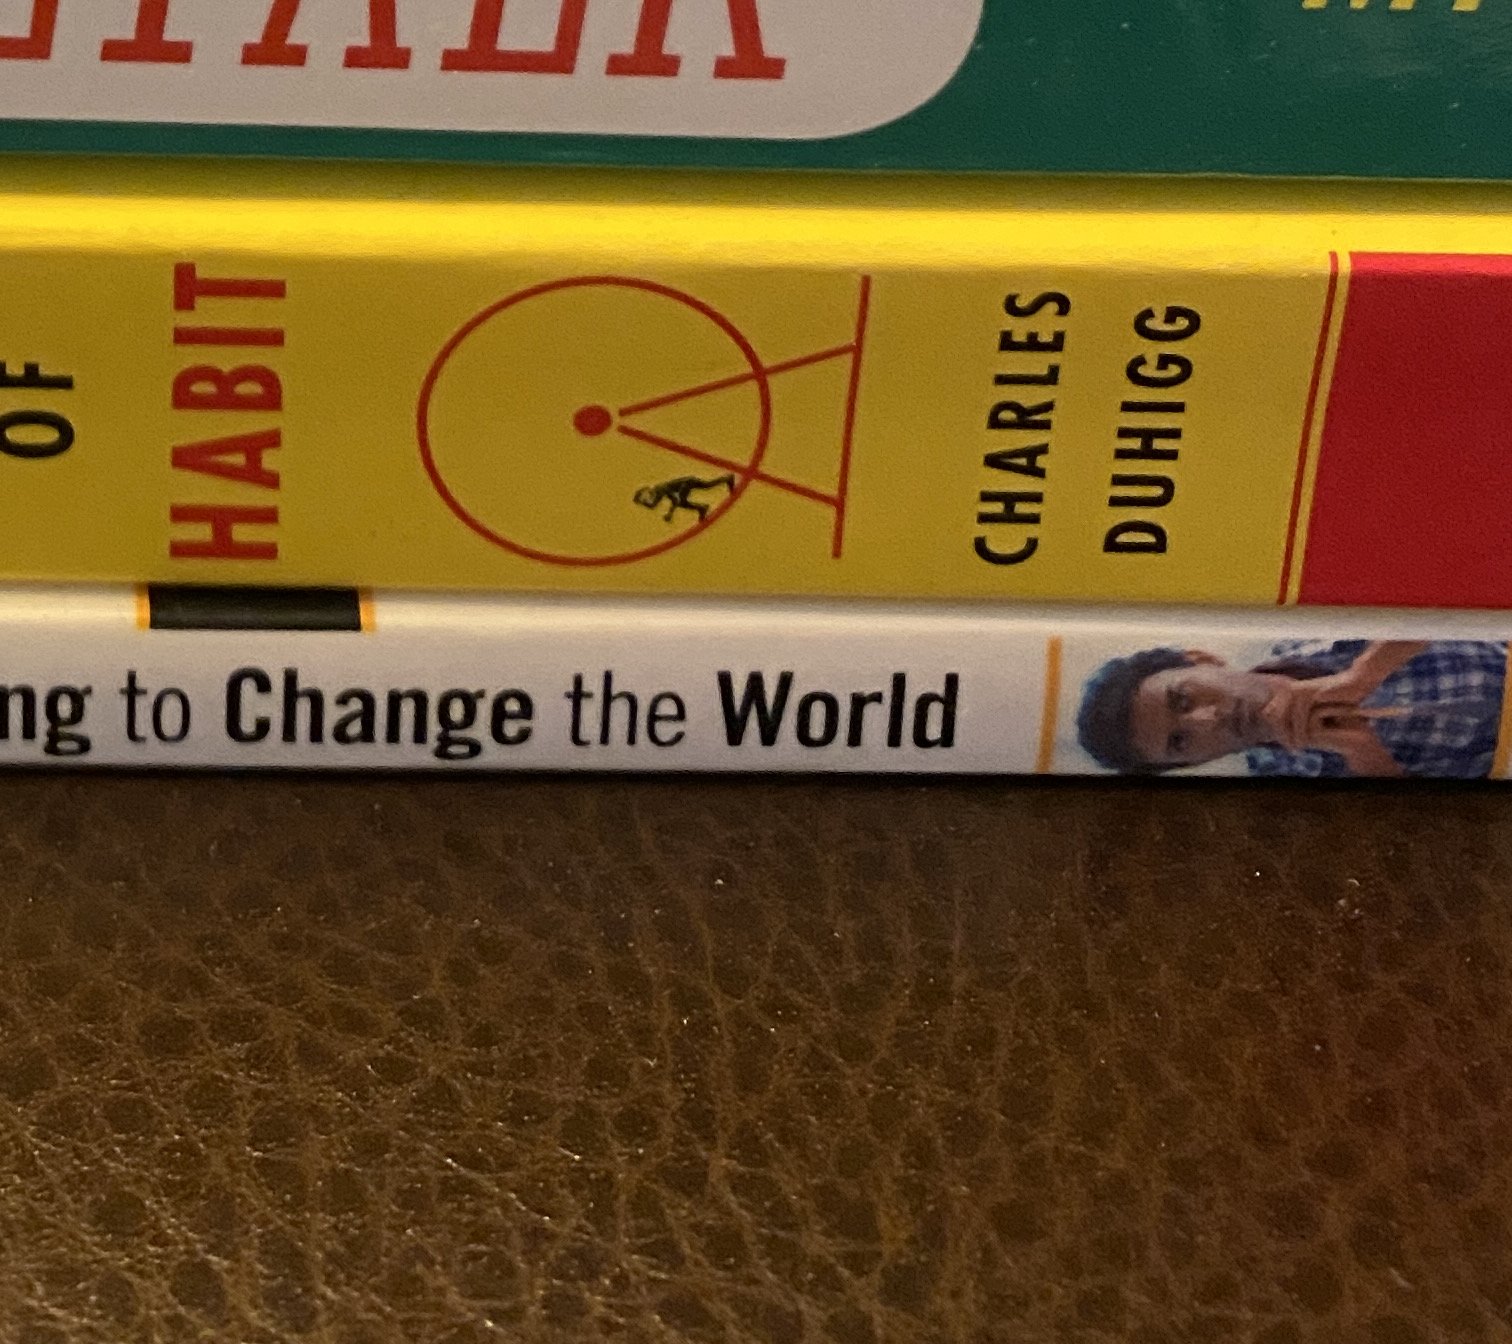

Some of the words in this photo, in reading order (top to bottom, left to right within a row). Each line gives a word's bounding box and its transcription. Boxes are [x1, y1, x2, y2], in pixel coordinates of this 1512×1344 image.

[168, 262, 287, 561] HABIT
[973, 291, 1072, 567] CHARLES
[1102, 305, 1202, 555] DUHIGG
[119, 670, 191, 745] to
[225, 667, 534, 761] Change
[564, 669, 687, 748] the
[717, 670, 959, 750] World
